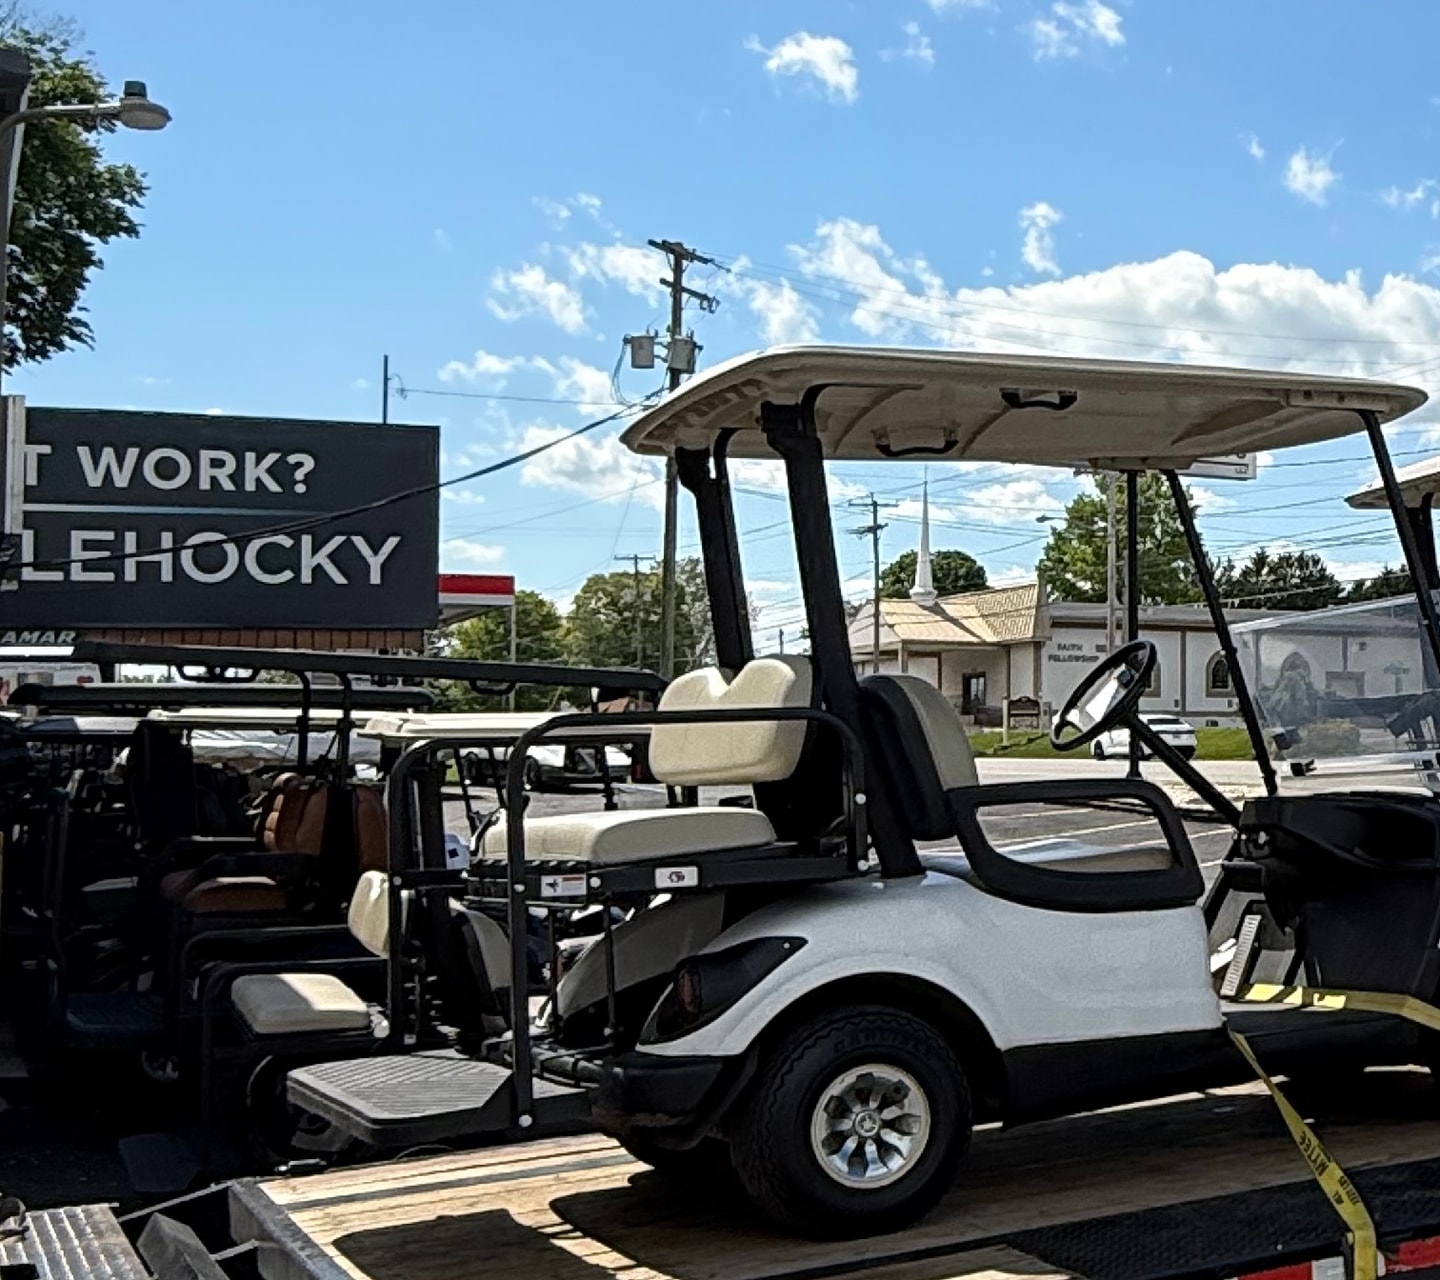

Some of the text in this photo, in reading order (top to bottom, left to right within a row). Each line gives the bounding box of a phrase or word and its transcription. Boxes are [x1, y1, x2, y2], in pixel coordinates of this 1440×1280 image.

[77, 445, 316, 494] WORK?
[21, 528, 402, 586] LEHOCKY
[1, 630, 76, 644] AMAR
